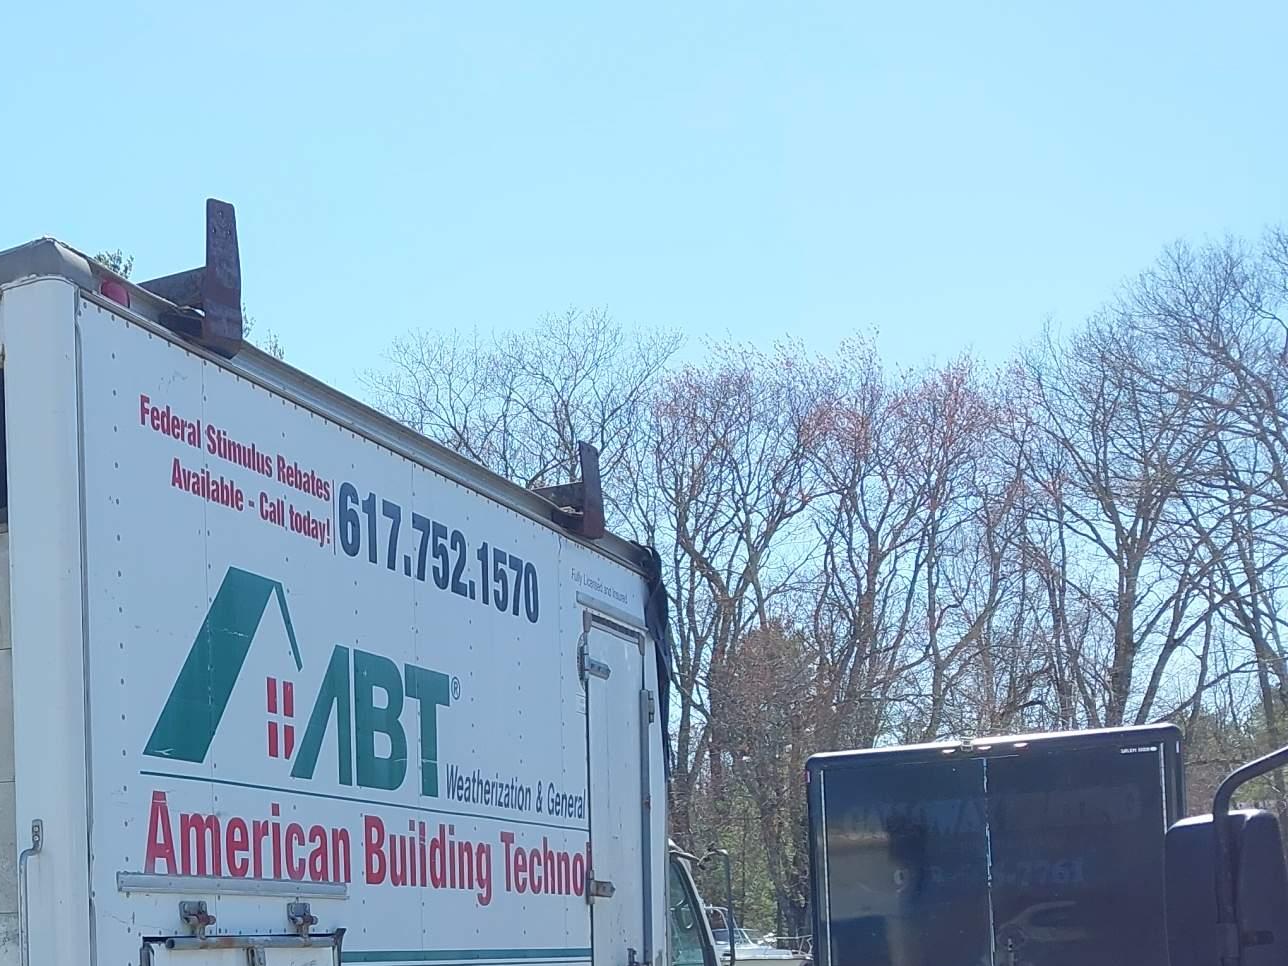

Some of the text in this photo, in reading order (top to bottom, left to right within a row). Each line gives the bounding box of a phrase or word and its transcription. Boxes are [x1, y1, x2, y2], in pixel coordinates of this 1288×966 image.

[140, 394, 330, 501] Federal Stimulus Rebates
[171, 459, 244, 511] Available
[259, 492, 285, 528] Call
[290, 514, 330, 547] today!
[338, 481, 540, 624] 617.752.1570
[446, 763, 586, 819] Weatherization & General
[144, 791, 351, 883] American
[364, 815, 492, 906] Building
